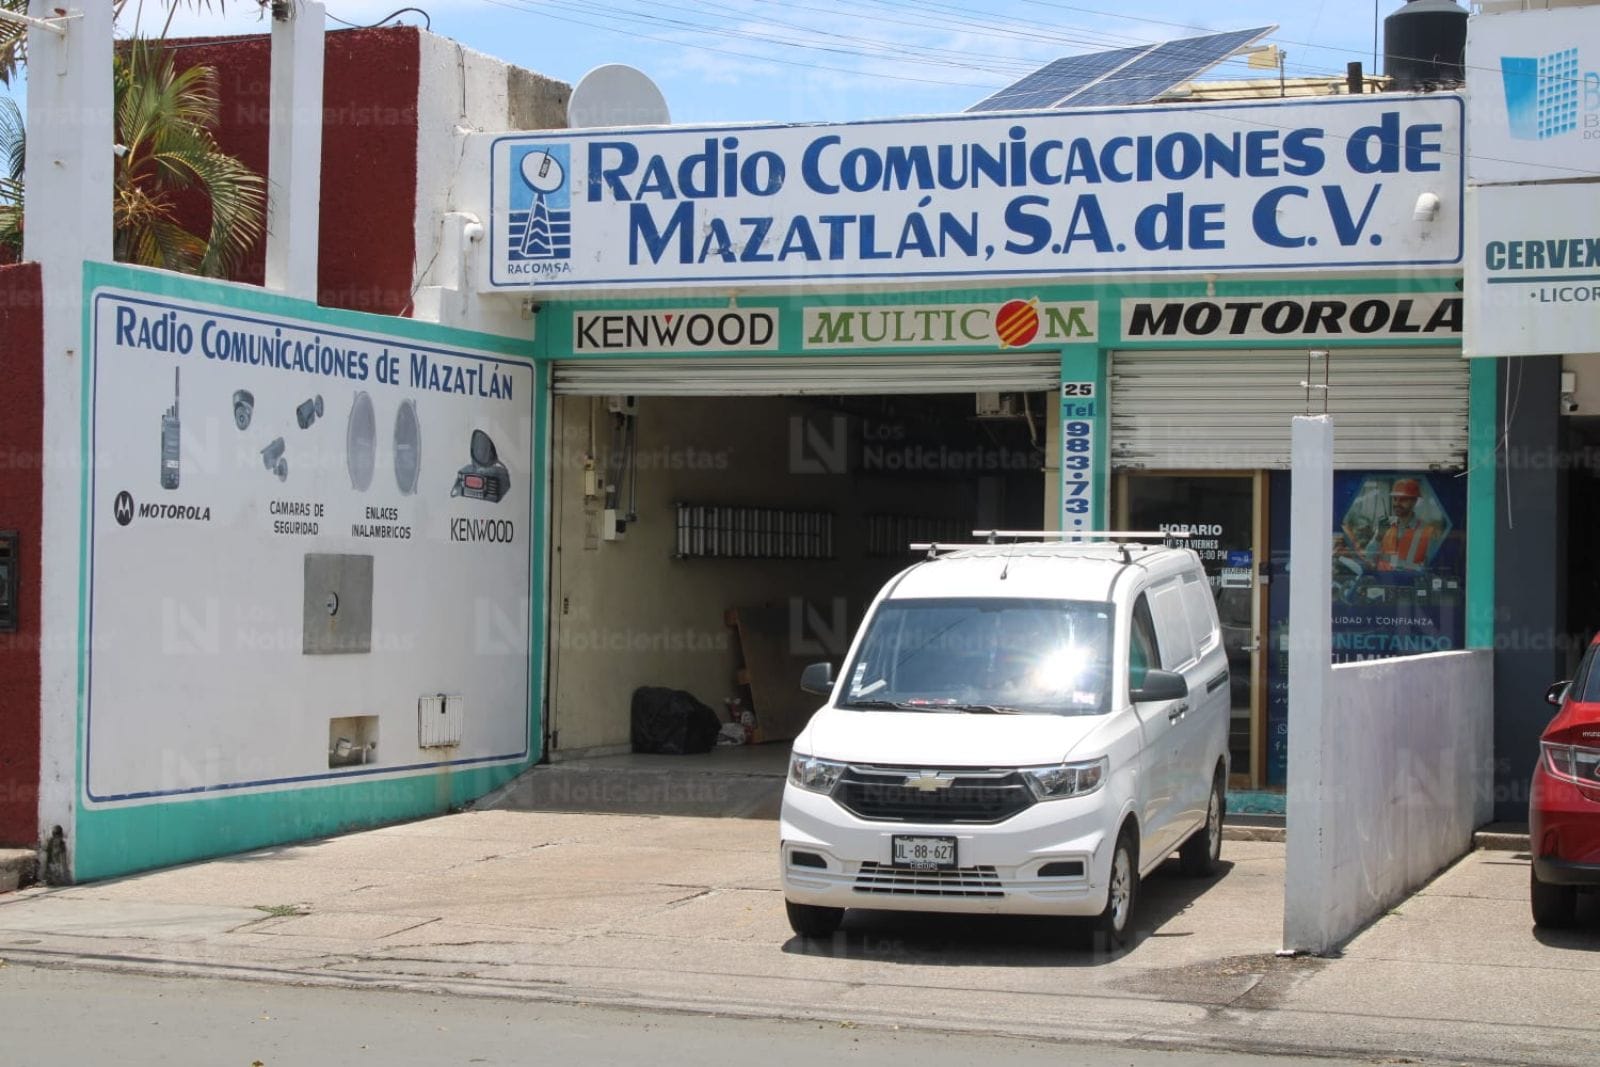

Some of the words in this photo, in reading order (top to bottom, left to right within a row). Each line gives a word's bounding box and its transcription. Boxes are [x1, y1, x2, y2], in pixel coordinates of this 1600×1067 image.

[508, 263, 572, 275] RACOMSA
[1128, 298, 1463, 337] MOTOROLA
[577, 312, 774, 349] KENWOOD
[1065, 383, 1092, 396] 25
[138, 502, 211, 521] MOTOROLA
[314, 503, 324, 517] DE
[365, 506, 398, 521] ENLACES
[273, 520, 319, 536] SEGURIDAD
[351, 523, 412, 539] INALAMBRICOS
[450, 517, 514, 543] KENWOOD
[1159, 524, 1223, 536] HORARIO
[1190, 539, 1219, 549] VIERNES
[1375, 616, 1434, 626] CONFIANZA
[895, 844, 953, 859] UL-88-627
